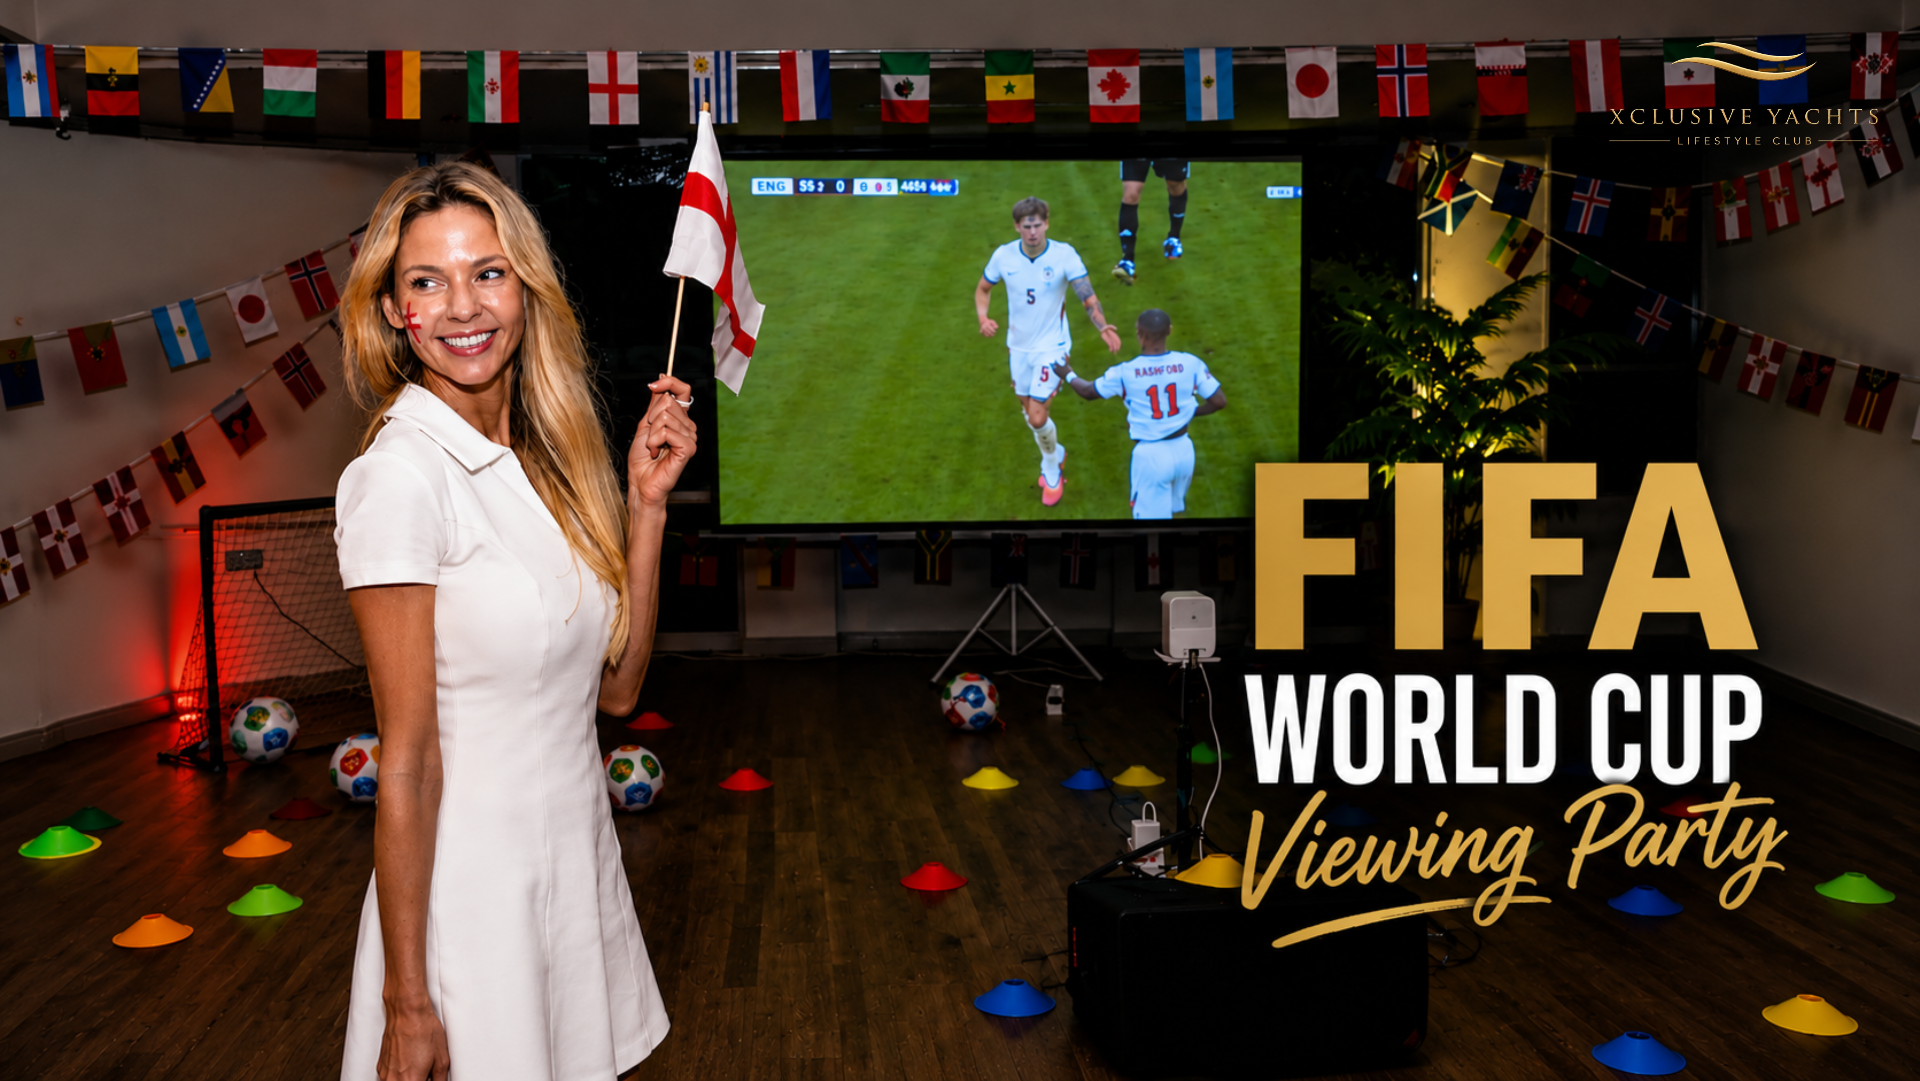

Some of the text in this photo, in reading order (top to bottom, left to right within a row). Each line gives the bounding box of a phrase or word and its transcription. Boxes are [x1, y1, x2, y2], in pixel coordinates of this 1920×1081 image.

[757, 180, 786, 192] ENG
[1026, 288, 1036, 305] 5
[1040, 365, 1049, 382] 5
[1146, 382, 1179, 419] 11
